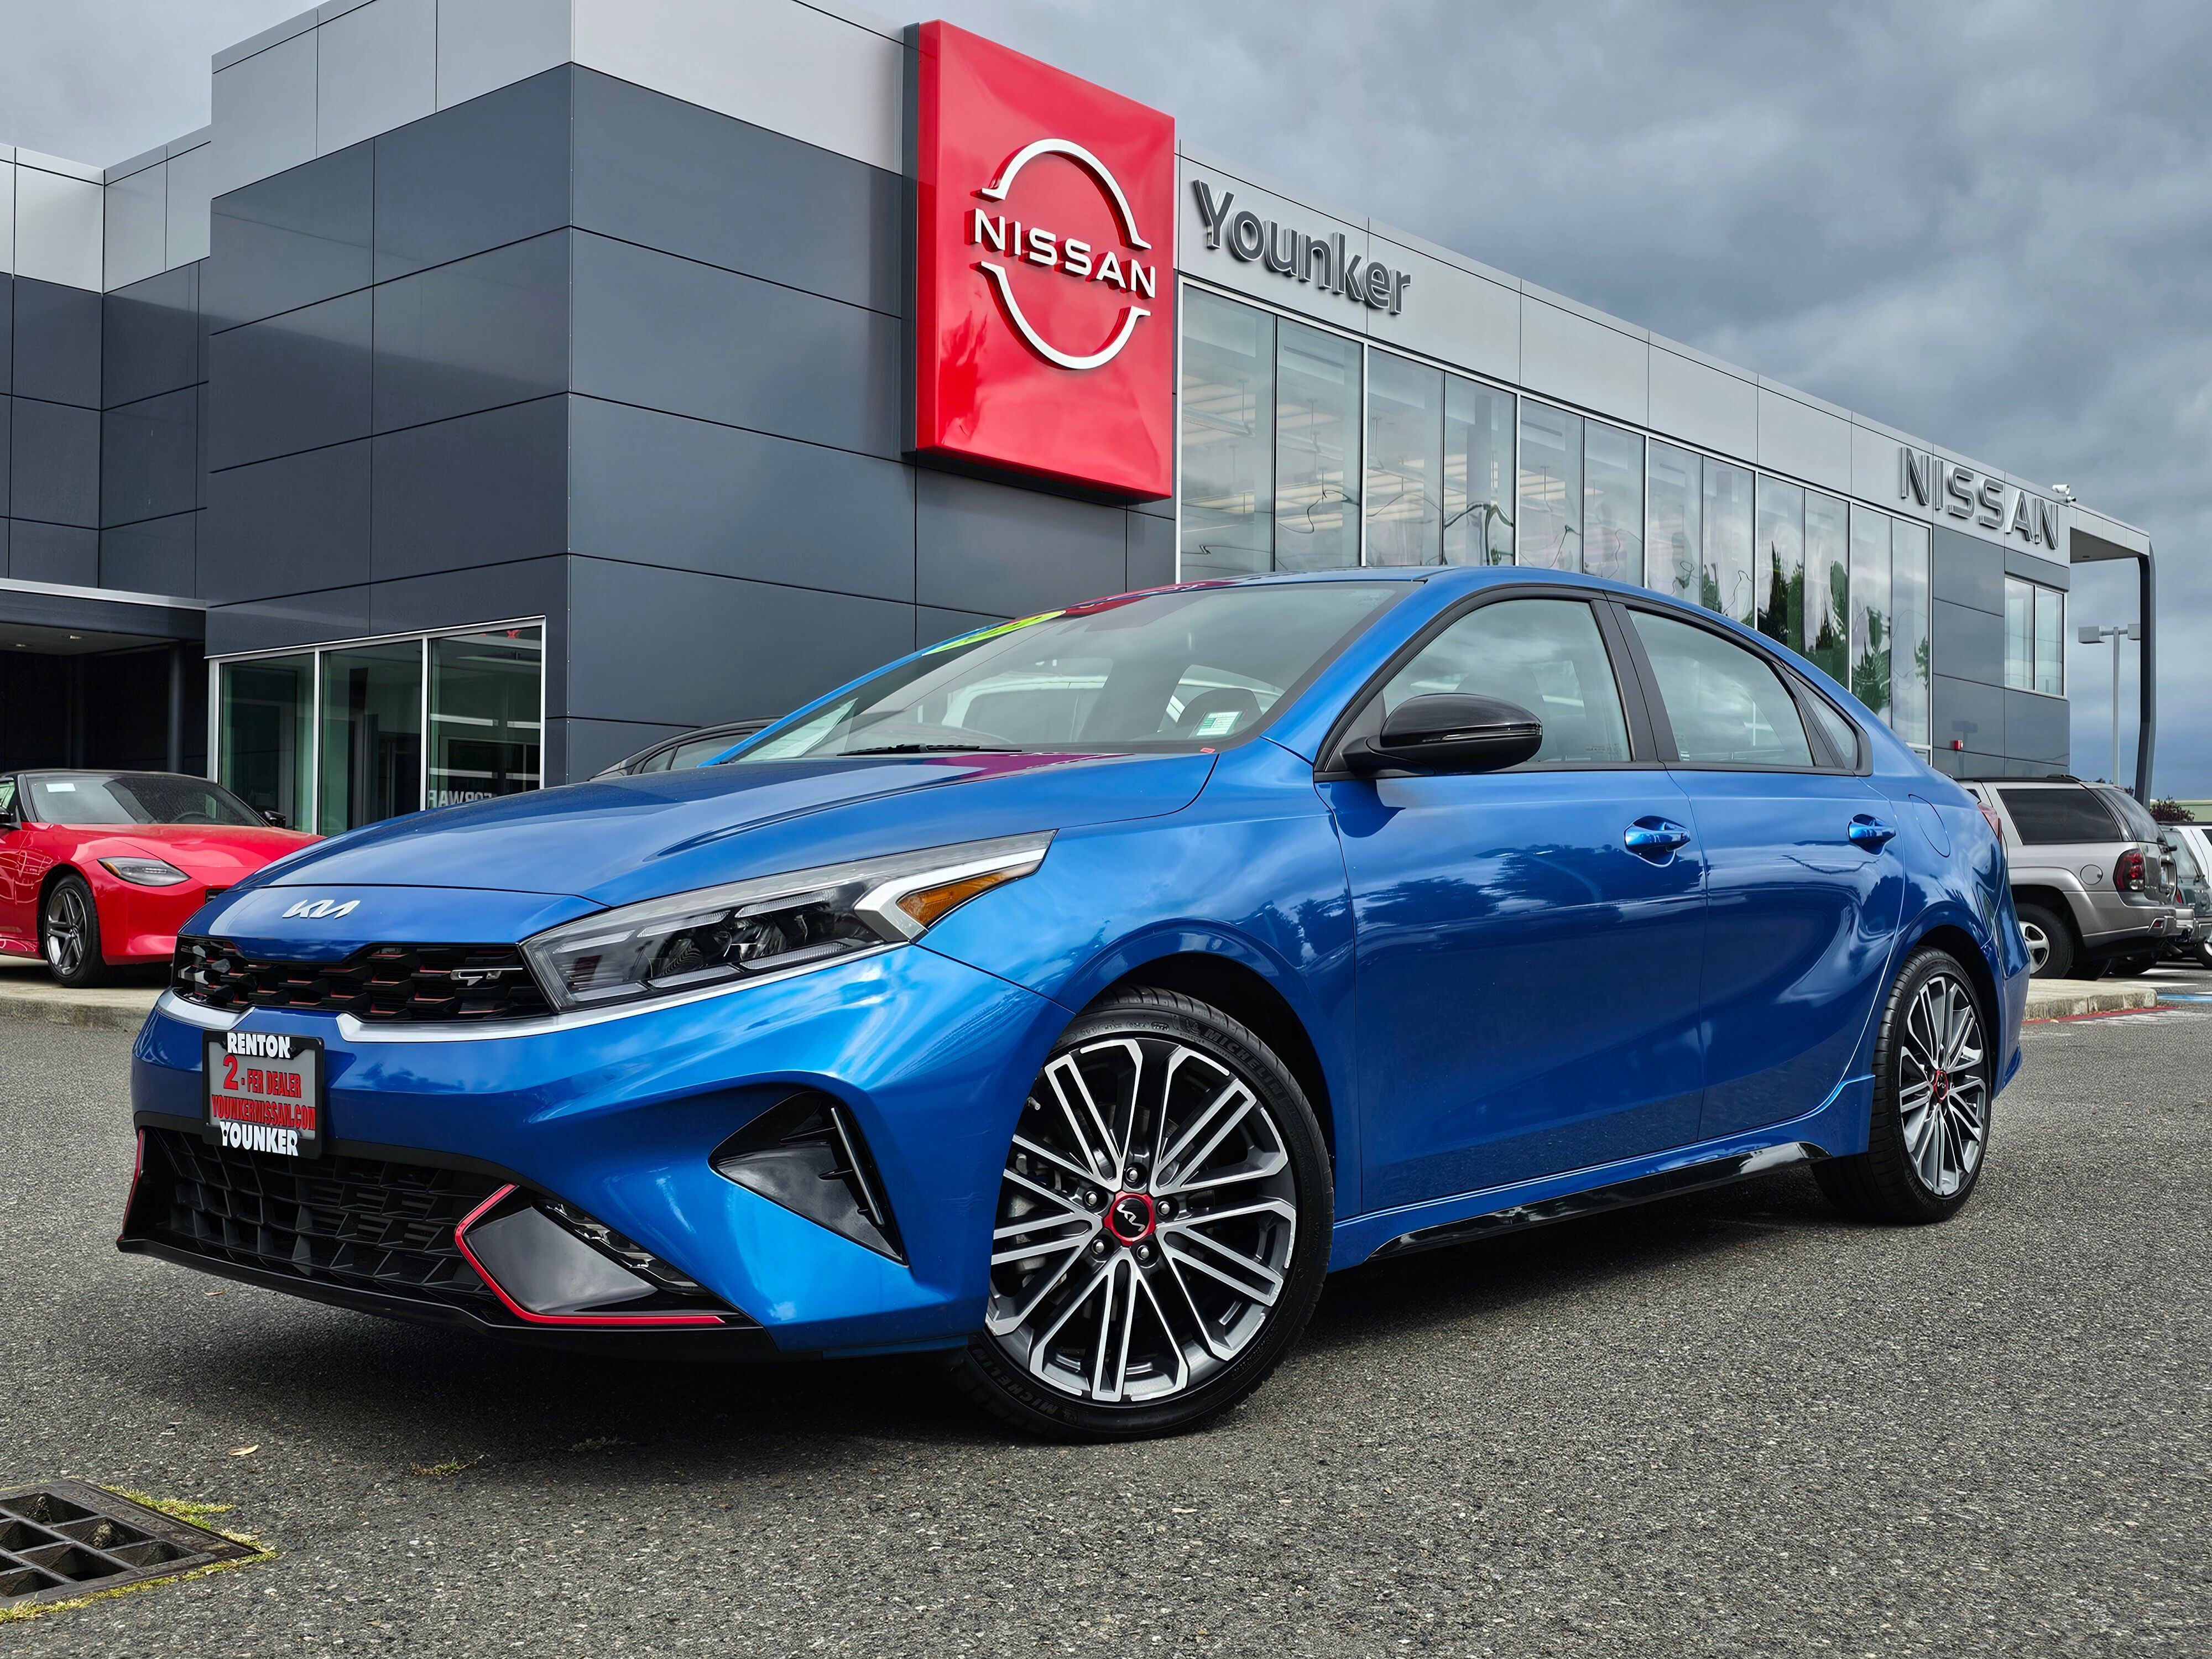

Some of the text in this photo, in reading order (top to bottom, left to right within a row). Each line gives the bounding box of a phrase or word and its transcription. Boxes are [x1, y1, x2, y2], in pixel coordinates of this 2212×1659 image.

[973, 208, 1156, 299] NISSAN
[1192, 179, 1411, 315] Younker
[1900, 447, 2059, 550] NISSAN
[281, 899, 361, 919] KIA
[227, 1032, 291, 1058] RENTON
[1204, 1029, 1282, 1095] MICHELIN
[266, 1071, 301, 1098] DEALER
[211, 1094, 316, 1130] YOUNKERNISSAN.COM
[220, 1121, 299, 1156] YOUNKER
[972, 1348, 1059, 1415] MICHELIN
